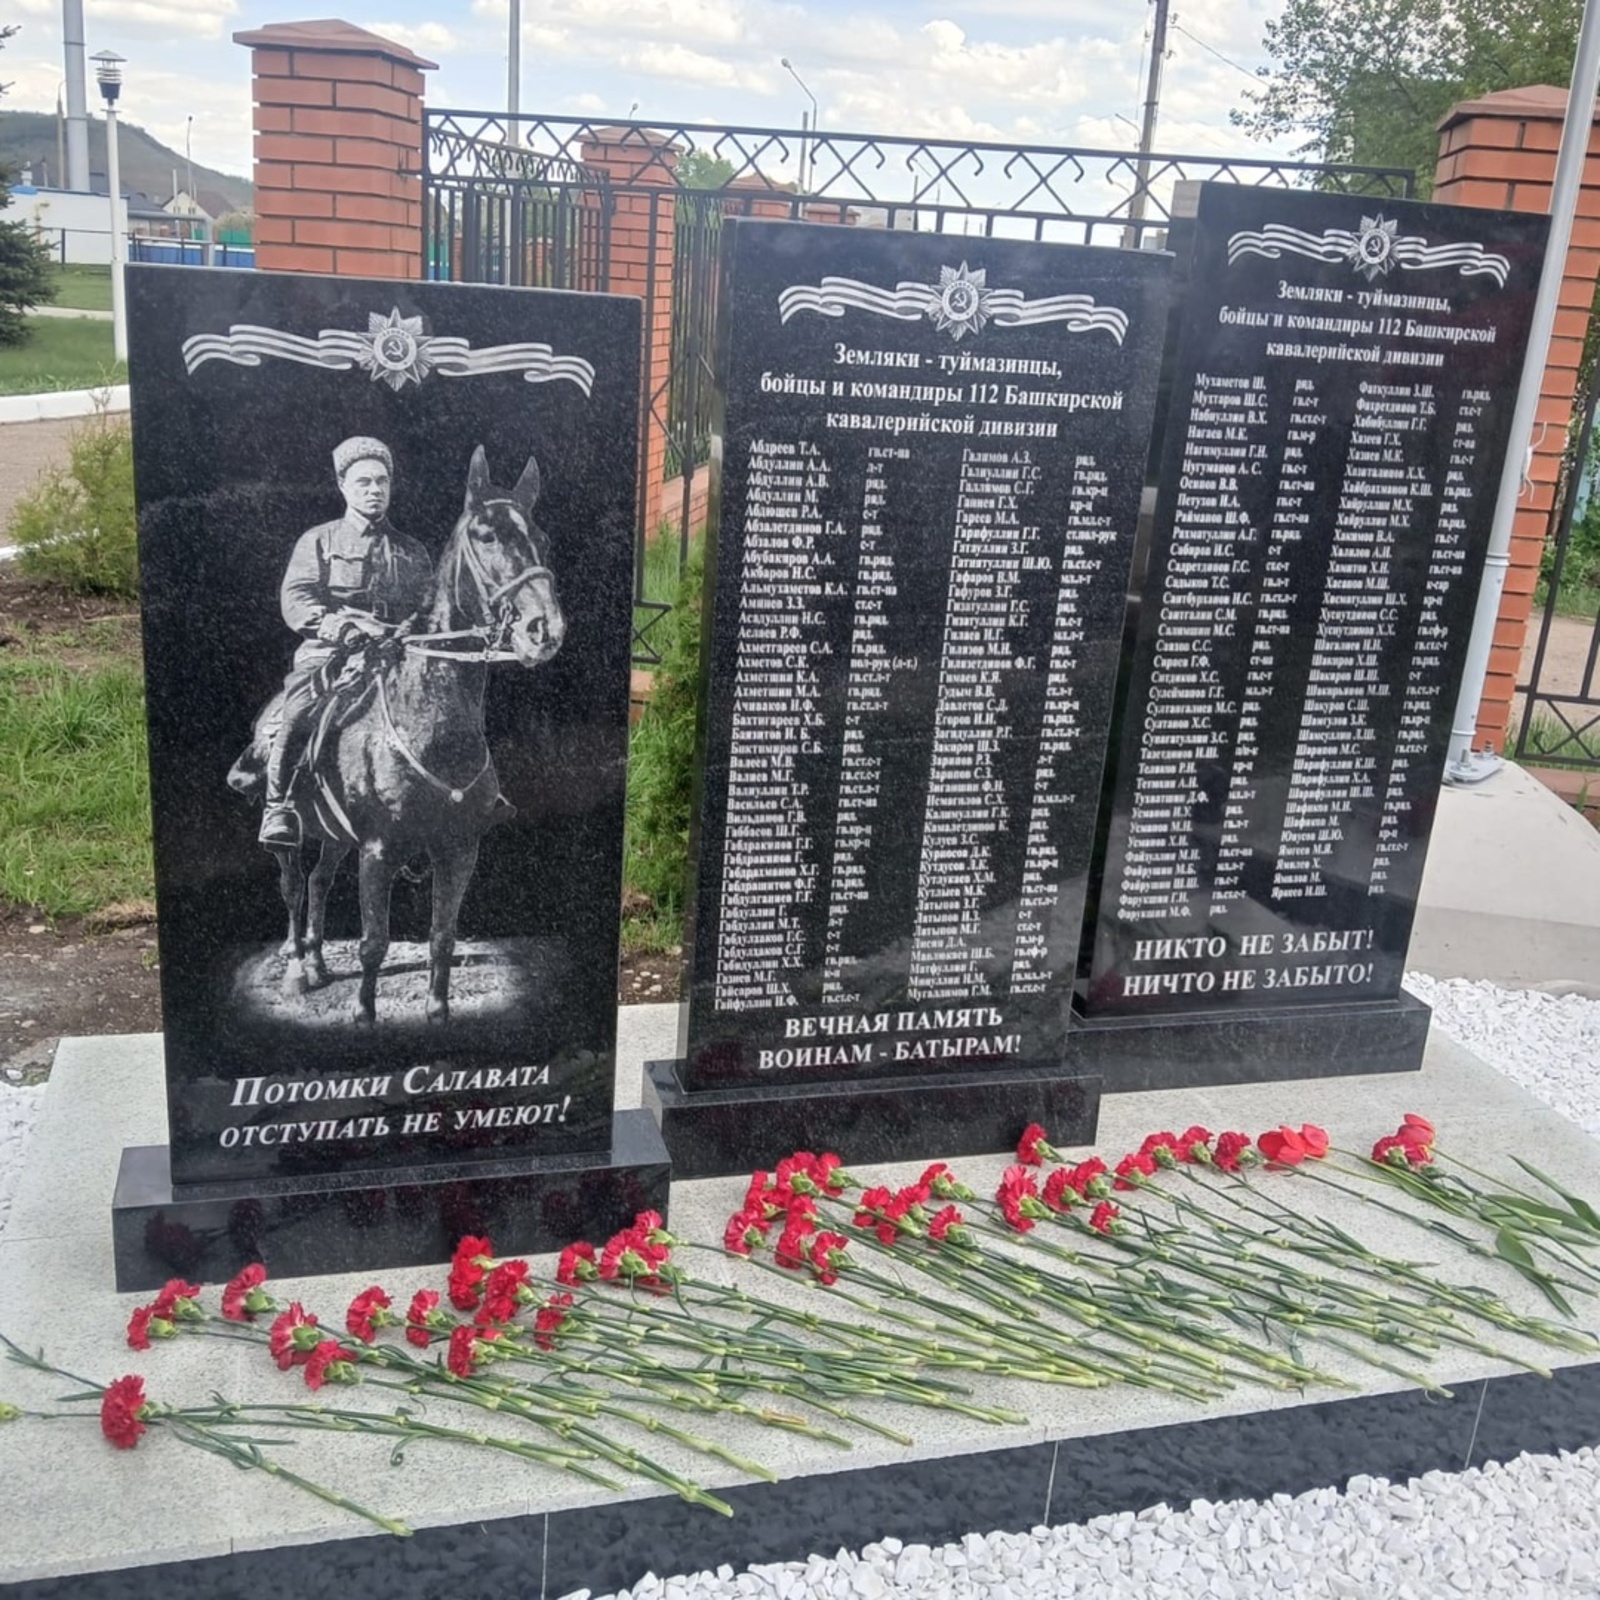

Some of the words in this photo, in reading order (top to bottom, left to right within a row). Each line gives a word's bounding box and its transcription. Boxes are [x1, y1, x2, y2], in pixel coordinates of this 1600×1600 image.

[1277, 280, 1343, 302] Земляки
[1358, 290, 1451, 314] туймазинцы,
[1219, 306, 1269, 327] бойцы
[1274, 312, 1282, 326] и
[1288, 314, 1373, 334] командиры
[1378, 318, 1400, 336] 112
[1404, 320, 1497, 344] Башкирской
[834, 342, 920, 368] Земляки
[938, 353, 1062, 379] туймазинцы,
[1266, 342, 1380, 363] кавалерийской
[1382, 350, 1444, 366] дивизии
[760, 372, 826, 397] бойцы
[832, 379, 844, 396] и
[851, 380, 962, 406] командиры
[970, 383, 999, 404] 112
[1004, 385, 1123, 412] Башкирской
[826, 411, 974, 435] кавалерийской
[979, 420, 1058, 438] дивизии
[1133, 936, 1226, 961] НИКТО
[1239, 935, 1274, 956] НЕ
[1280, 930, 1373, 954] ЗАБЫТ!
[1122, 972, 1215, 996] НИЧТО
[1221, 970, 1256, 991] НЕ
[1262, 963, 1373, 989] ЗАБЫТО!
[784, 1014, 889, 1038] ВЕЧНАЯ
[898, 1008, 1002, 1031] ПАМЯТЬ
[759, 1043, 872, 1070] ВОИНАМ
[894, 1034, 1021, 1060] БАТЫРАМ!
